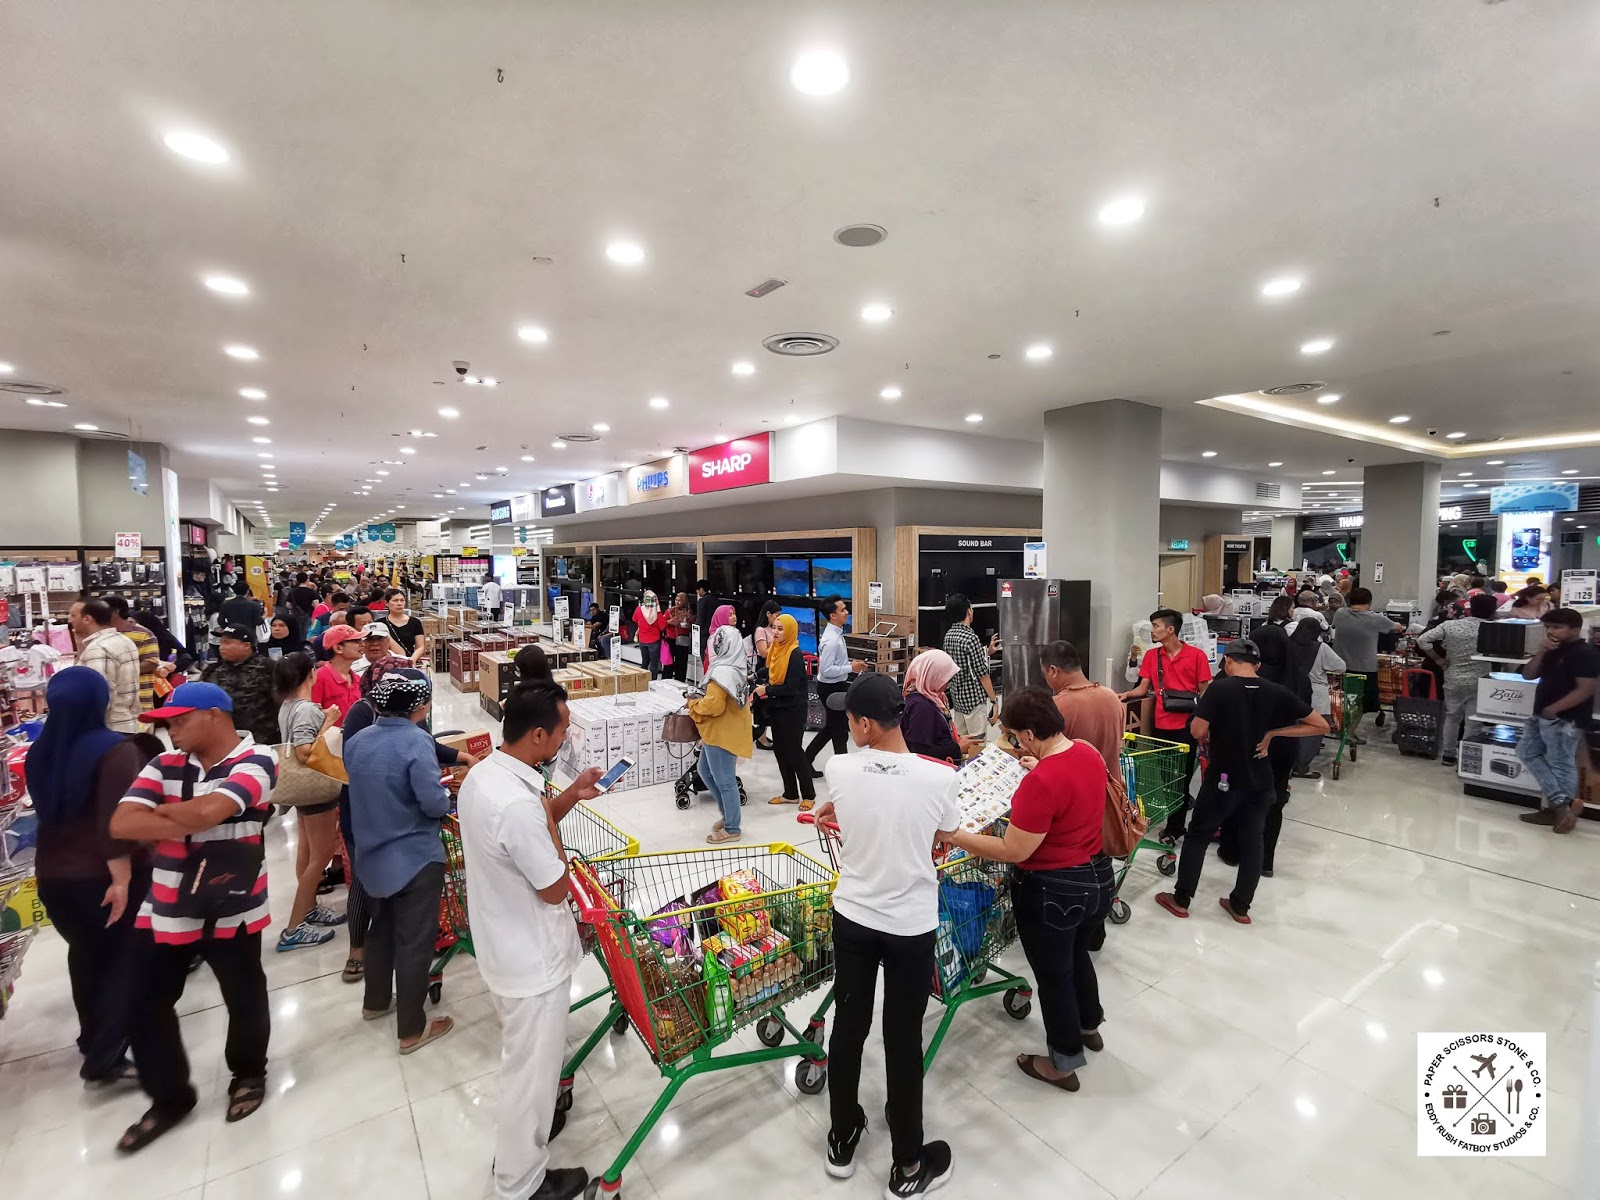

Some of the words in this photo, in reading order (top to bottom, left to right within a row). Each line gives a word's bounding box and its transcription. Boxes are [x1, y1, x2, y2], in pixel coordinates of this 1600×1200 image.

[702, 453, 752, 478] SHARP
[117, 539, 139, 547] 40%
[1577, 592, 1592, 600] 129
[1490, 688, 1525, 700] Batik
[470, 739, 488, 748] Kari
